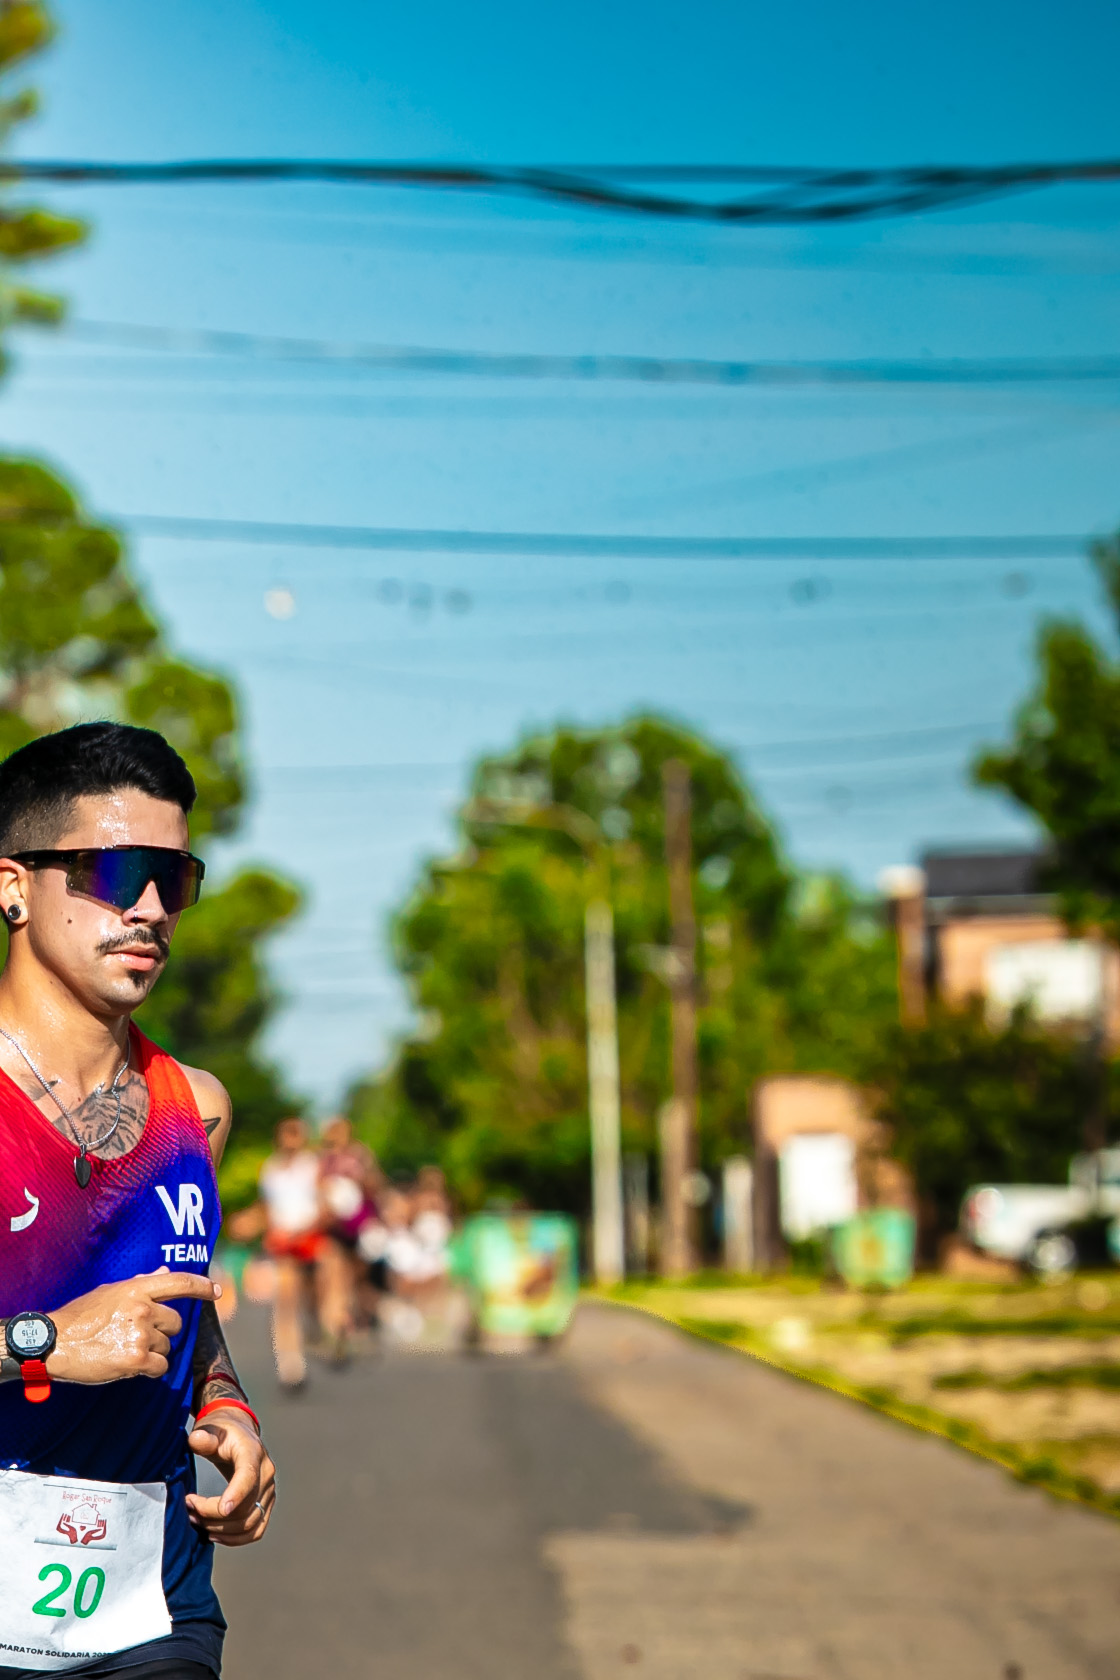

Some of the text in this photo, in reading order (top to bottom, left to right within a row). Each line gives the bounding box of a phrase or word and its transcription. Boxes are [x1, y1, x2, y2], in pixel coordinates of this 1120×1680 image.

[155, 1183, 206, 1236] VR
[161, 1244, 208, 1262] TEAM
[81, 1493, 93, 1502] San
[32, 1563, 106, 1619] 20
[0, 1642, 43, 1656] MARATON
[45, 1649, 90, 1659] SOLIDARIA
